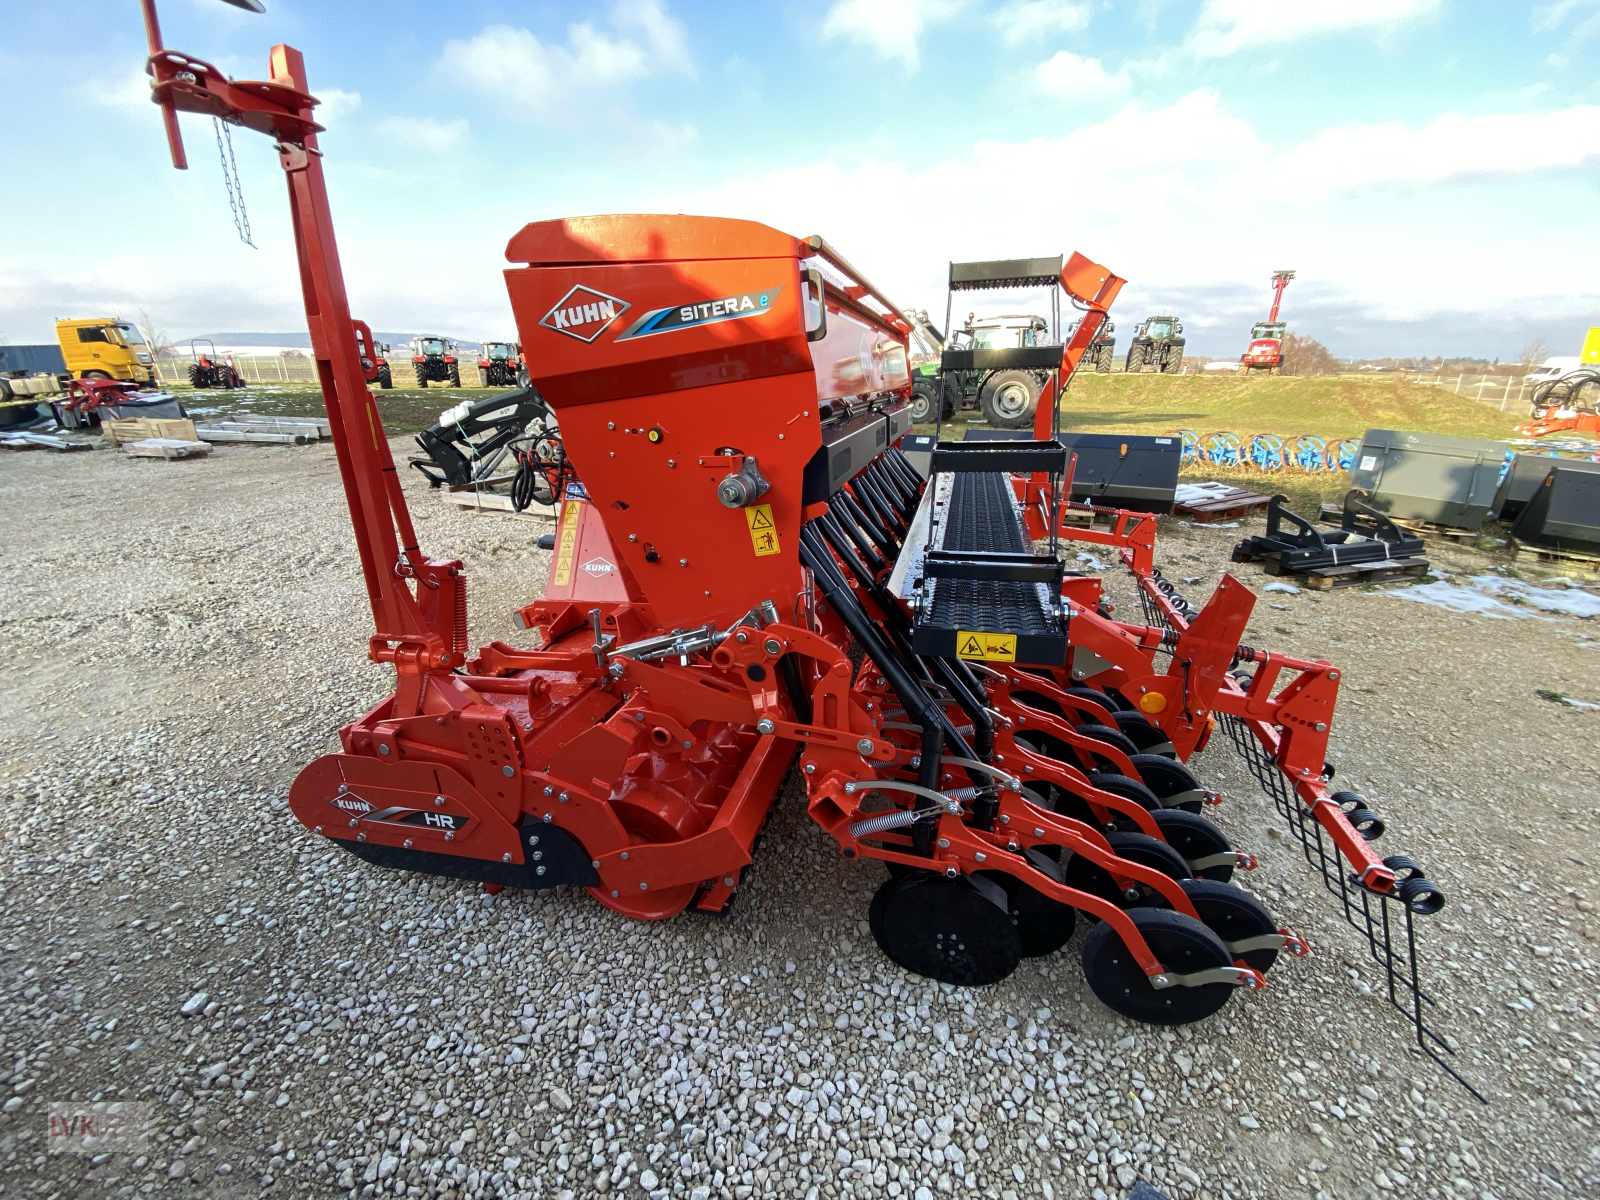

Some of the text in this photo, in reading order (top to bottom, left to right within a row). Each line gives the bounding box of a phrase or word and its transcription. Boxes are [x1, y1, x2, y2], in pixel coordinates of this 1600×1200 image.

[553, 299, 616, 329] KUHN
[680, 294, 769, 322] SITERA e
[585, 563, 611, 572] KUHN
[336, 799, 371, 813] KUHN
[424, 812, 456, 829] HR
